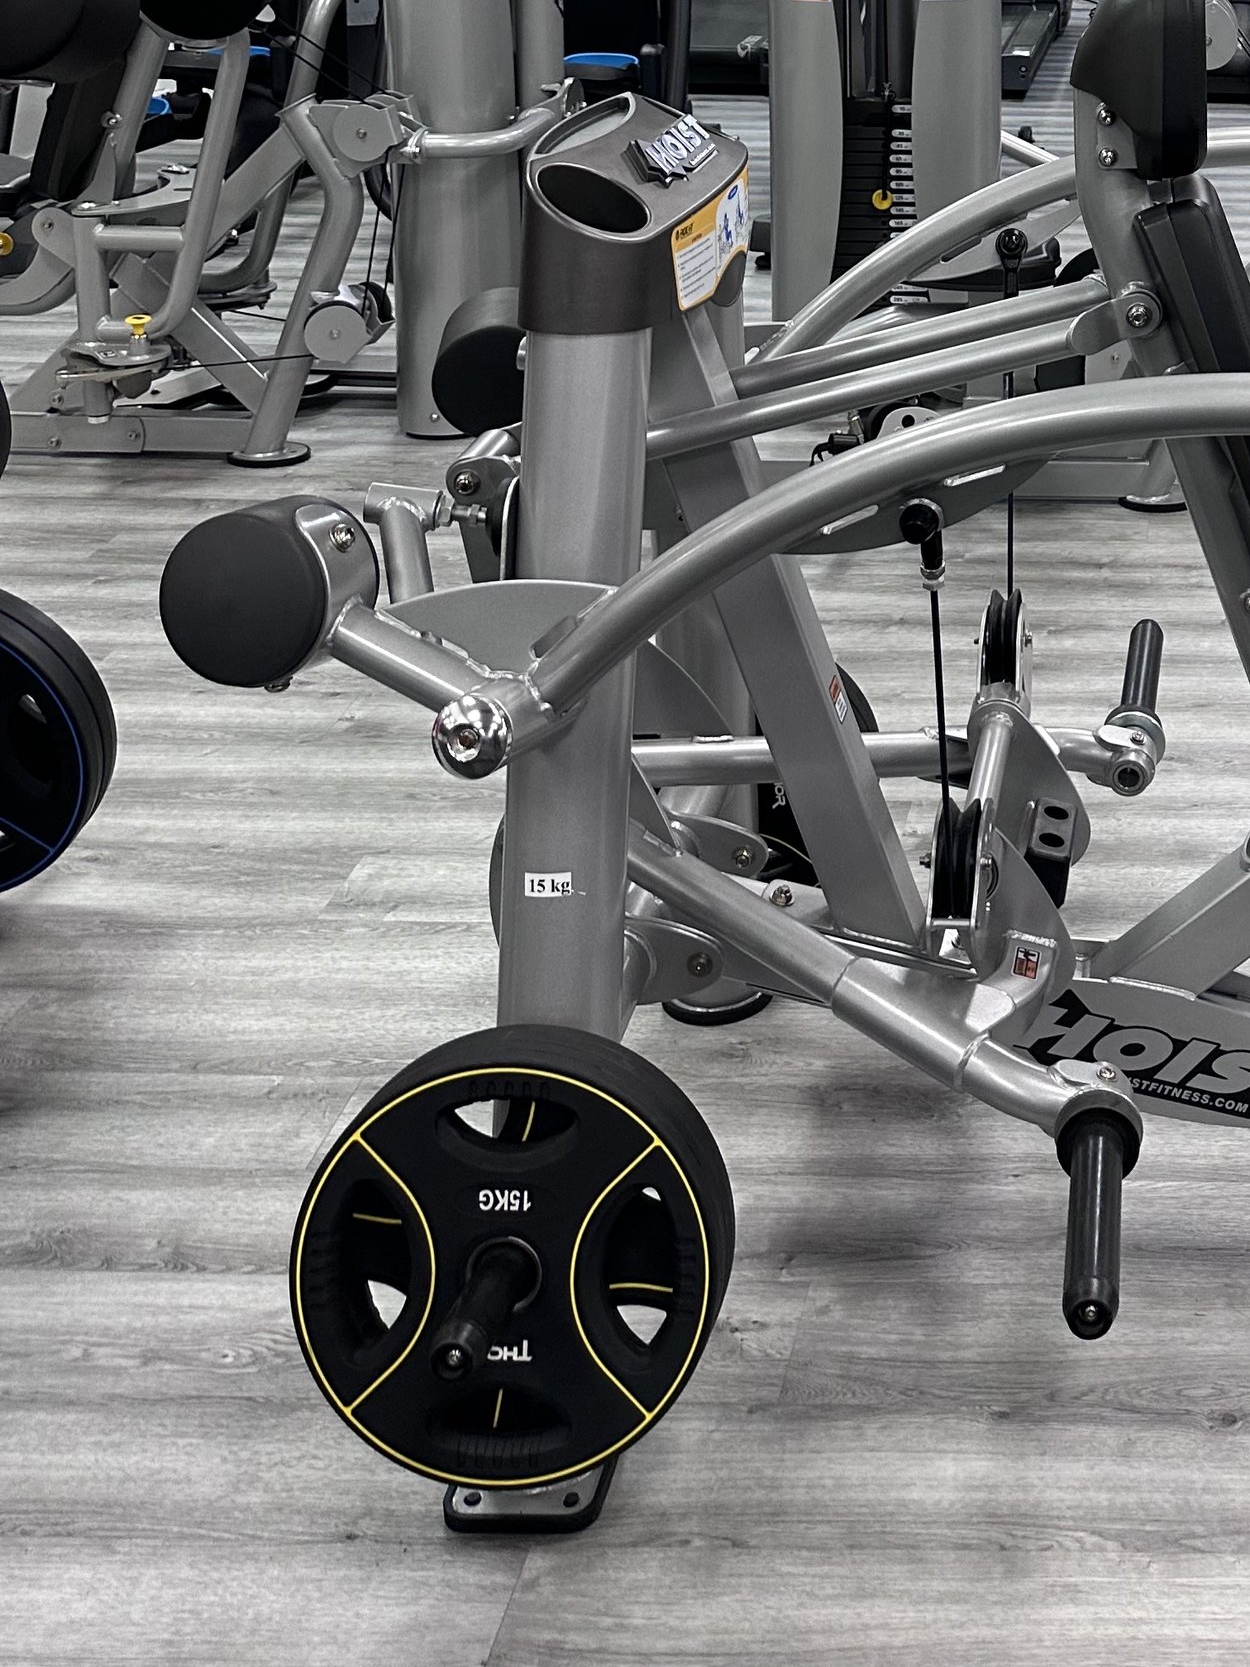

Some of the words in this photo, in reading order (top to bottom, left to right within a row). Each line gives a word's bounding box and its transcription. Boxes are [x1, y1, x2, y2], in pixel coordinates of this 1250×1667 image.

[645, 114, 711, 175] HOIST
[530, 878, 546, 894] 15
[551, 878, 570, 896] kg
[478, 1188, 532, 1212] 15KG
